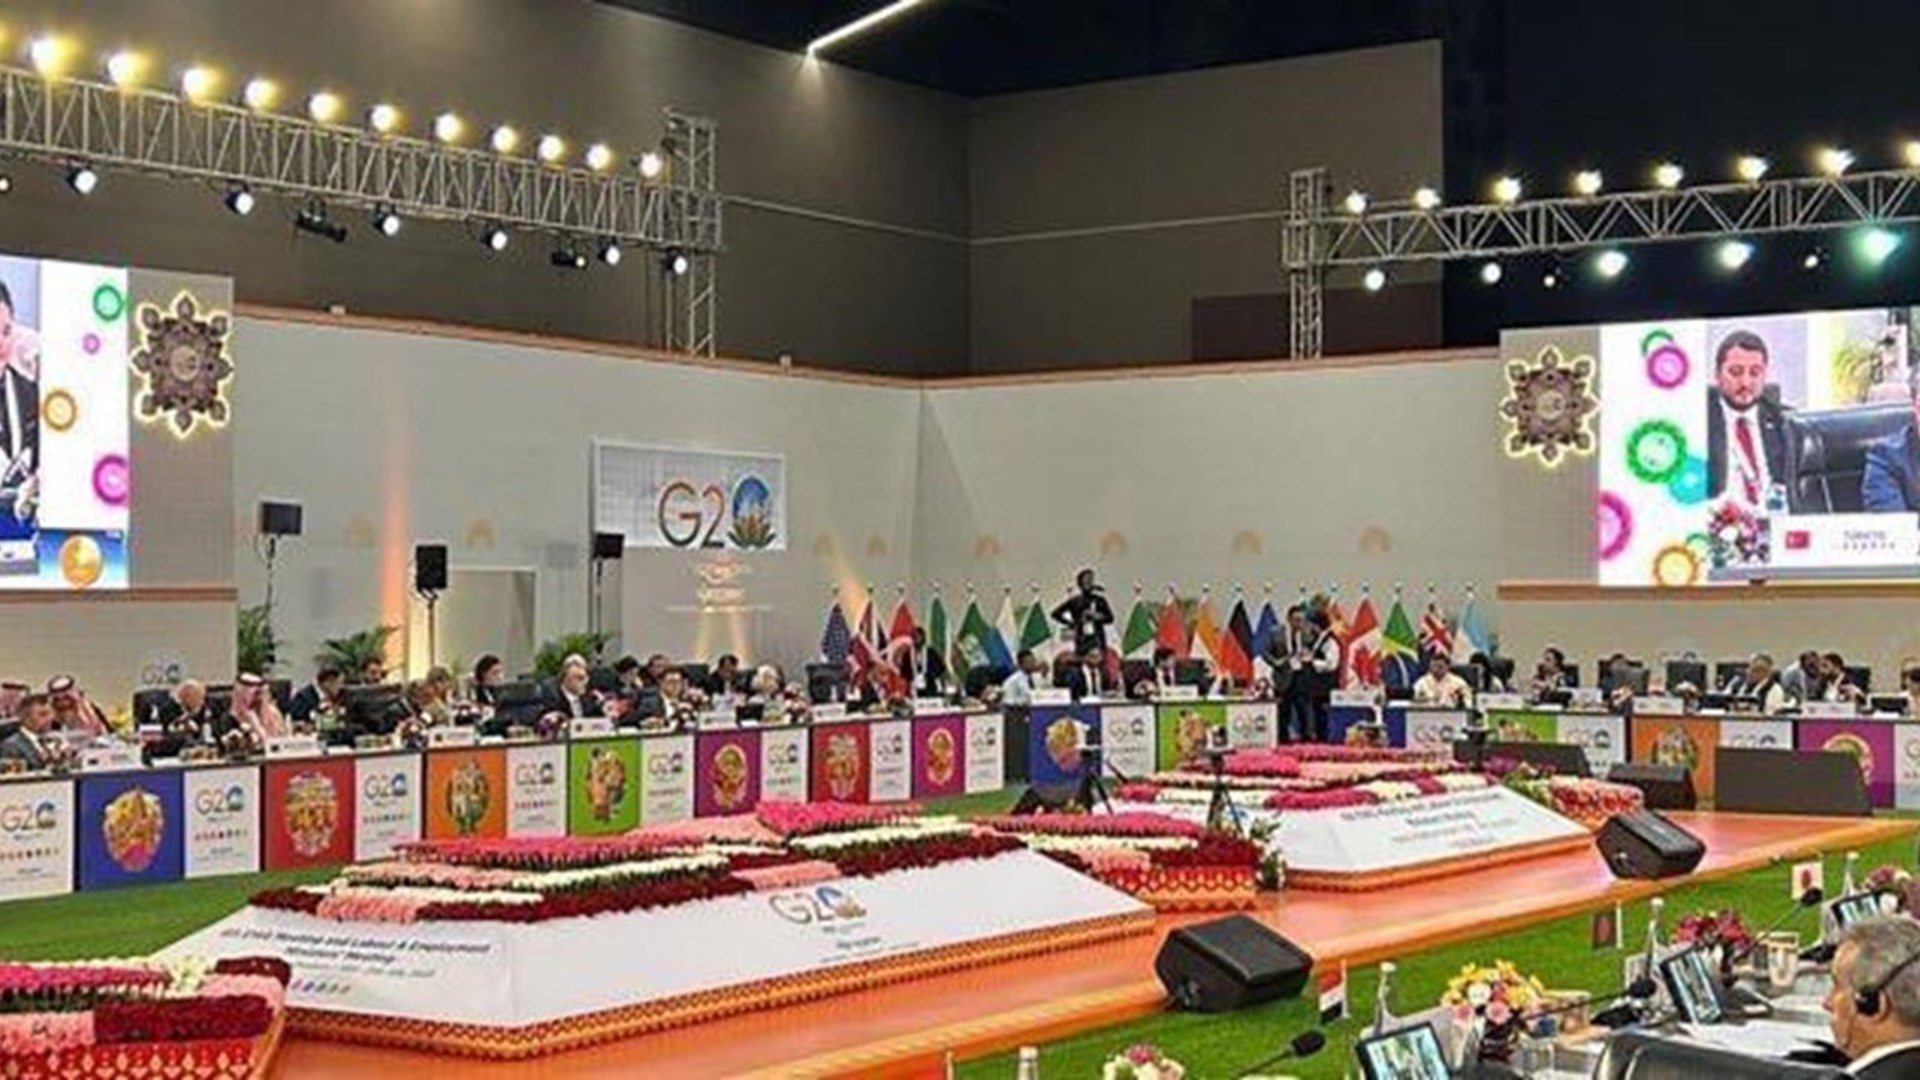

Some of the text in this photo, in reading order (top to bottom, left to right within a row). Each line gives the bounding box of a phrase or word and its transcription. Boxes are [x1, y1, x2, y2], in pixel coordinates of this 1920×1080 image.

[657, 475, 776, 549] G20
[364, 772, 408, 799] G20
[516, 762, 555, 786] G20
[195, 786, 244, 816] G20
[1, 801, 56, 832] G20
[769, 886, 867, 924] G20
[408, 941, 491, 955] Employment
